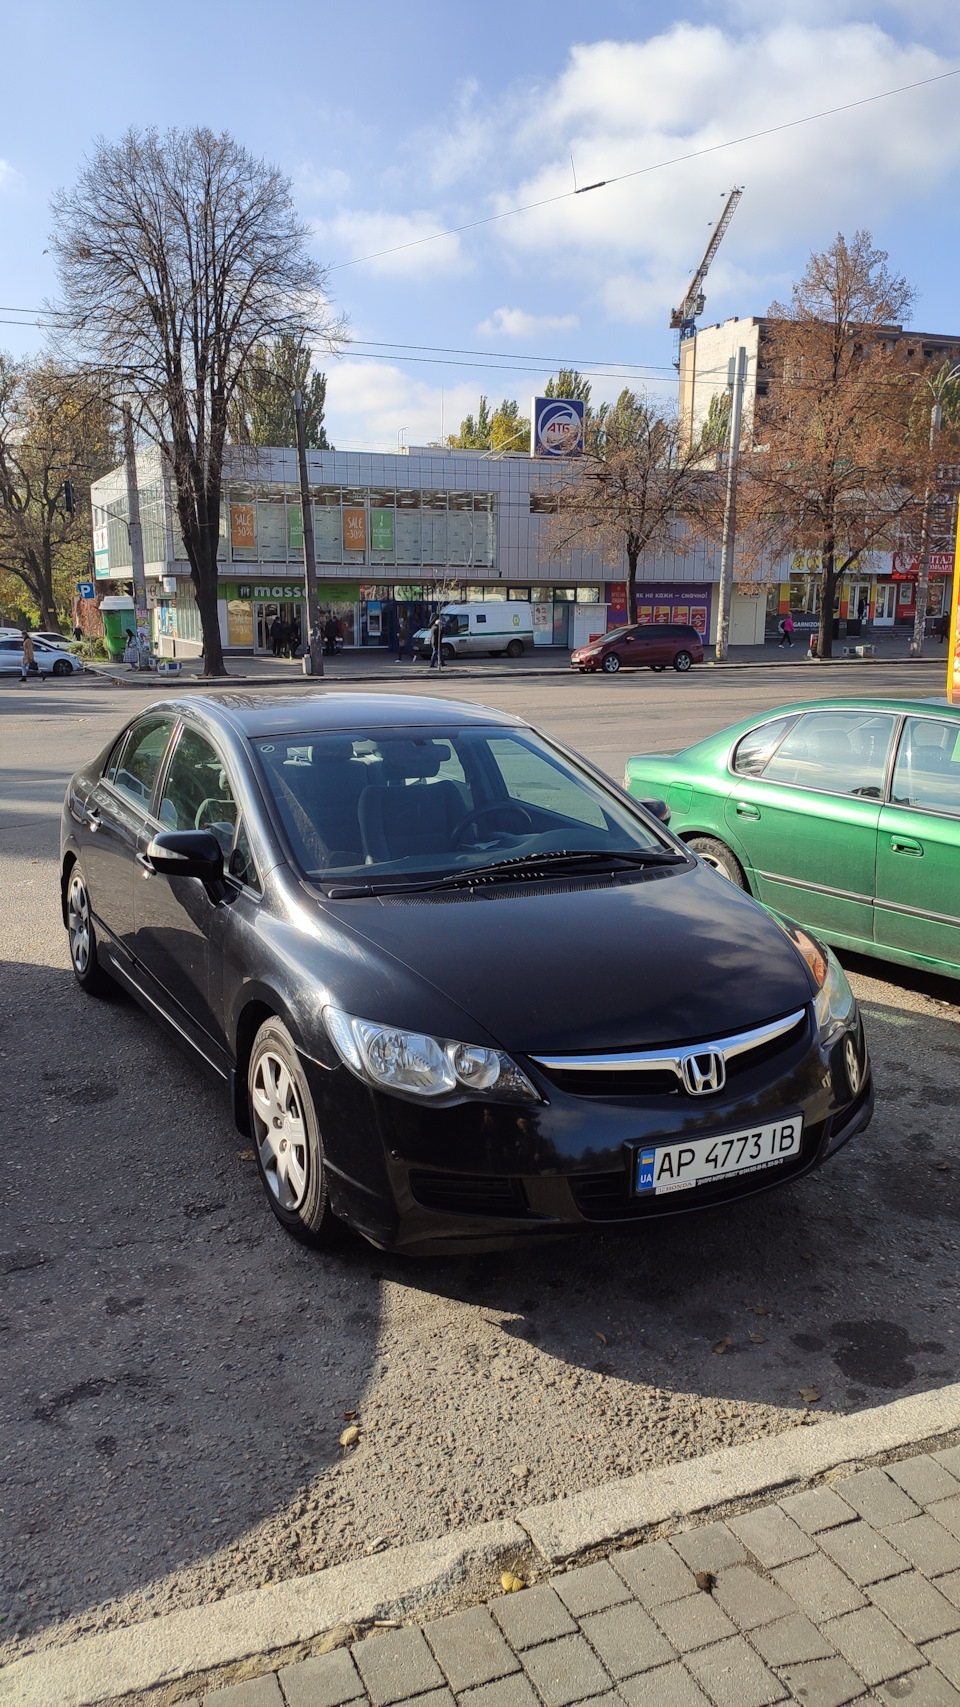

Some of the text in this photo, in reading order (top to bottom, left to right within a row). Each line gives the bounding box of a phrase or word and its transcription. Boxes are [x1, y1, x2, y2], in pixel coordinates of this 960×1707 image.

[235, 514, 251, 526] SALE
[347, 516, 363, 528] SALE
[233, 527, 253, 537] -30%
[346, 529, 364, 539] -30%
[681, 591, 707, 599] смачно!
[656, 1148, 696, 1181] AP
[705, 1132, 763, 1169] 4773
[640, 1173, 652, 1184] UA
[665, 1182, 693, 1192] HONDA
